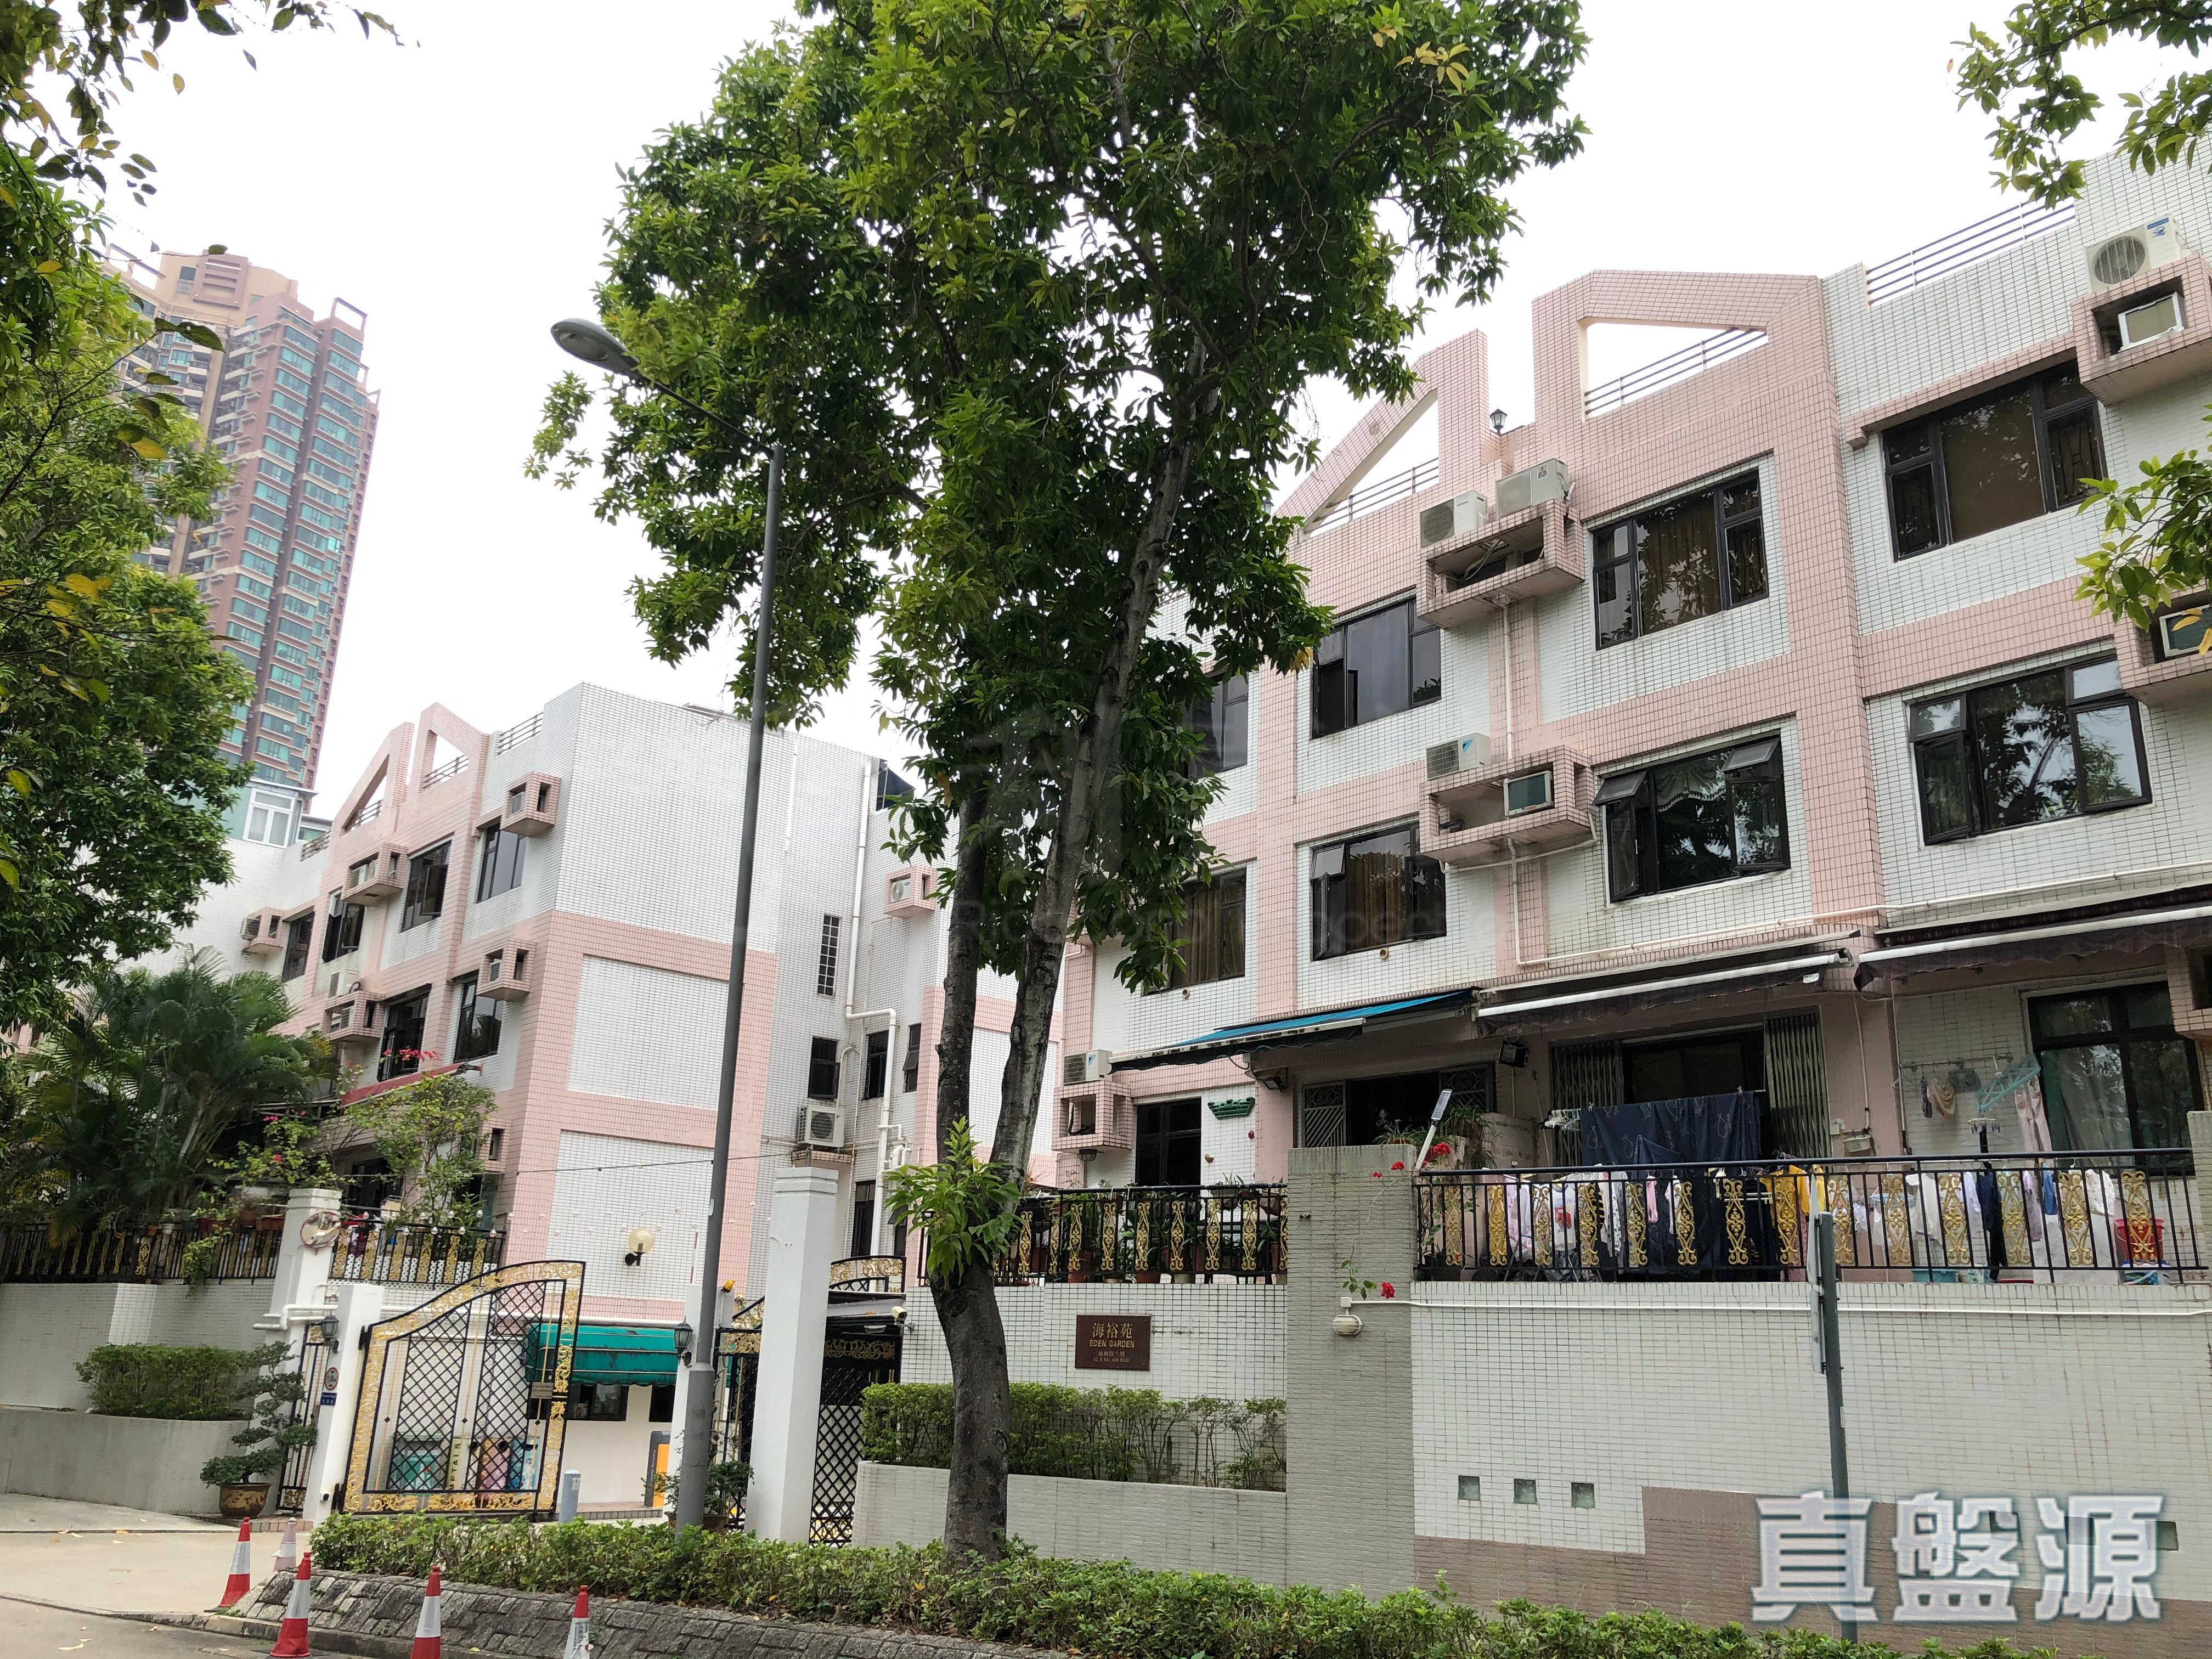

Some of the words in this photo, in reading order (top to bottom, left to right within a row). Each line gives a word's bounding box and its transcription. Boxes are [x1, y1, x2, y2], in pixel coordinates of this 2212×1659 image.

[1093, 1322, 1133, 1339] 海裕苑
[1090, 1339, 1107, 1347] EDEN
[1109, 1340, 1135, 1348] GARDEN
